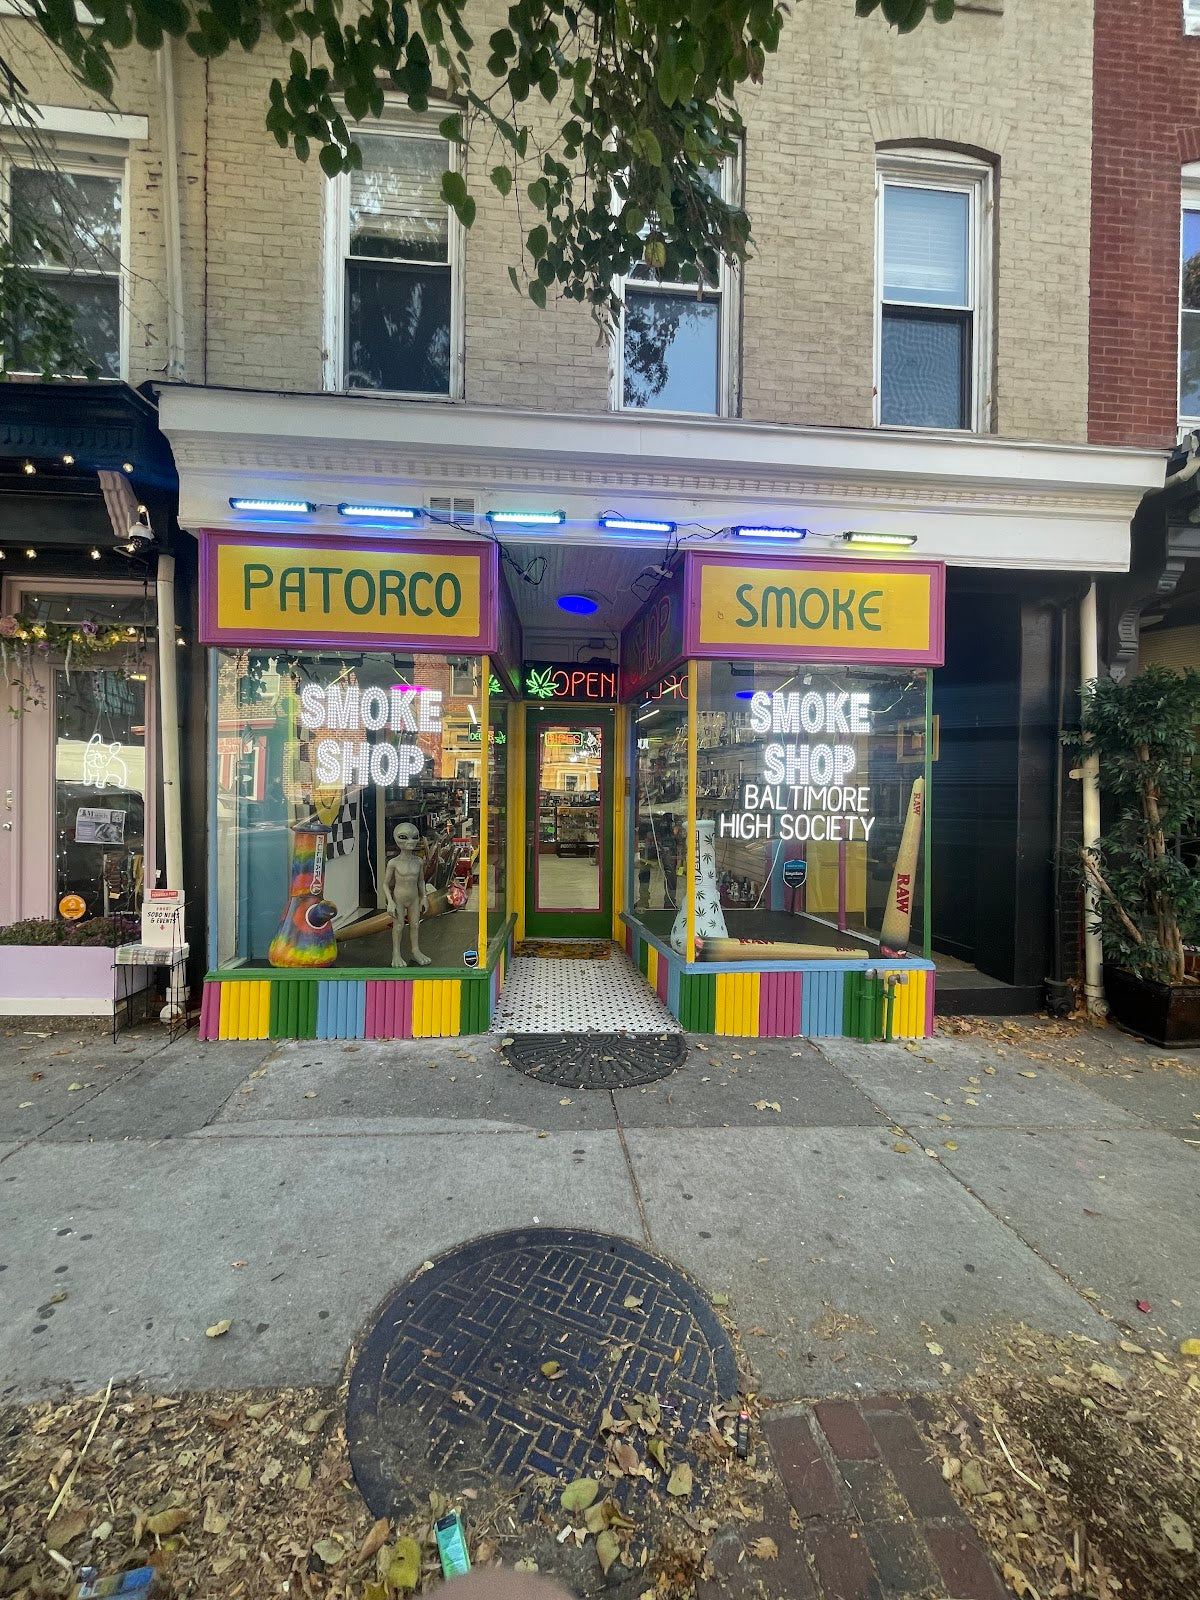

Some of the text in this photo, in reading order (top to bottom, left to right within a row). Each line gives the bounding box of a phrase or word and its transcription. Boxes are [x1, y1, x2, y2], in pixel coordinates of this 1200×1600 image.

[243, 563, 462, 618] PATORCO
[735, 583, 884, 631] SMOKE
[551, 670, 615, 698] OPEN
[299, 683, 443, 733] SMOKE
[749, 690, 871, 734] SMOKE
[315, 738, 425, 789] SHOP
[763, 743, 857, 786] SHOP
[744, 784, 871, 812] BALTIMORE
[912, 792, 921, 816] RAW
[720, 813, 876, 841] HIGH SOCIETY
[896, 873, 911, 915] RAW
